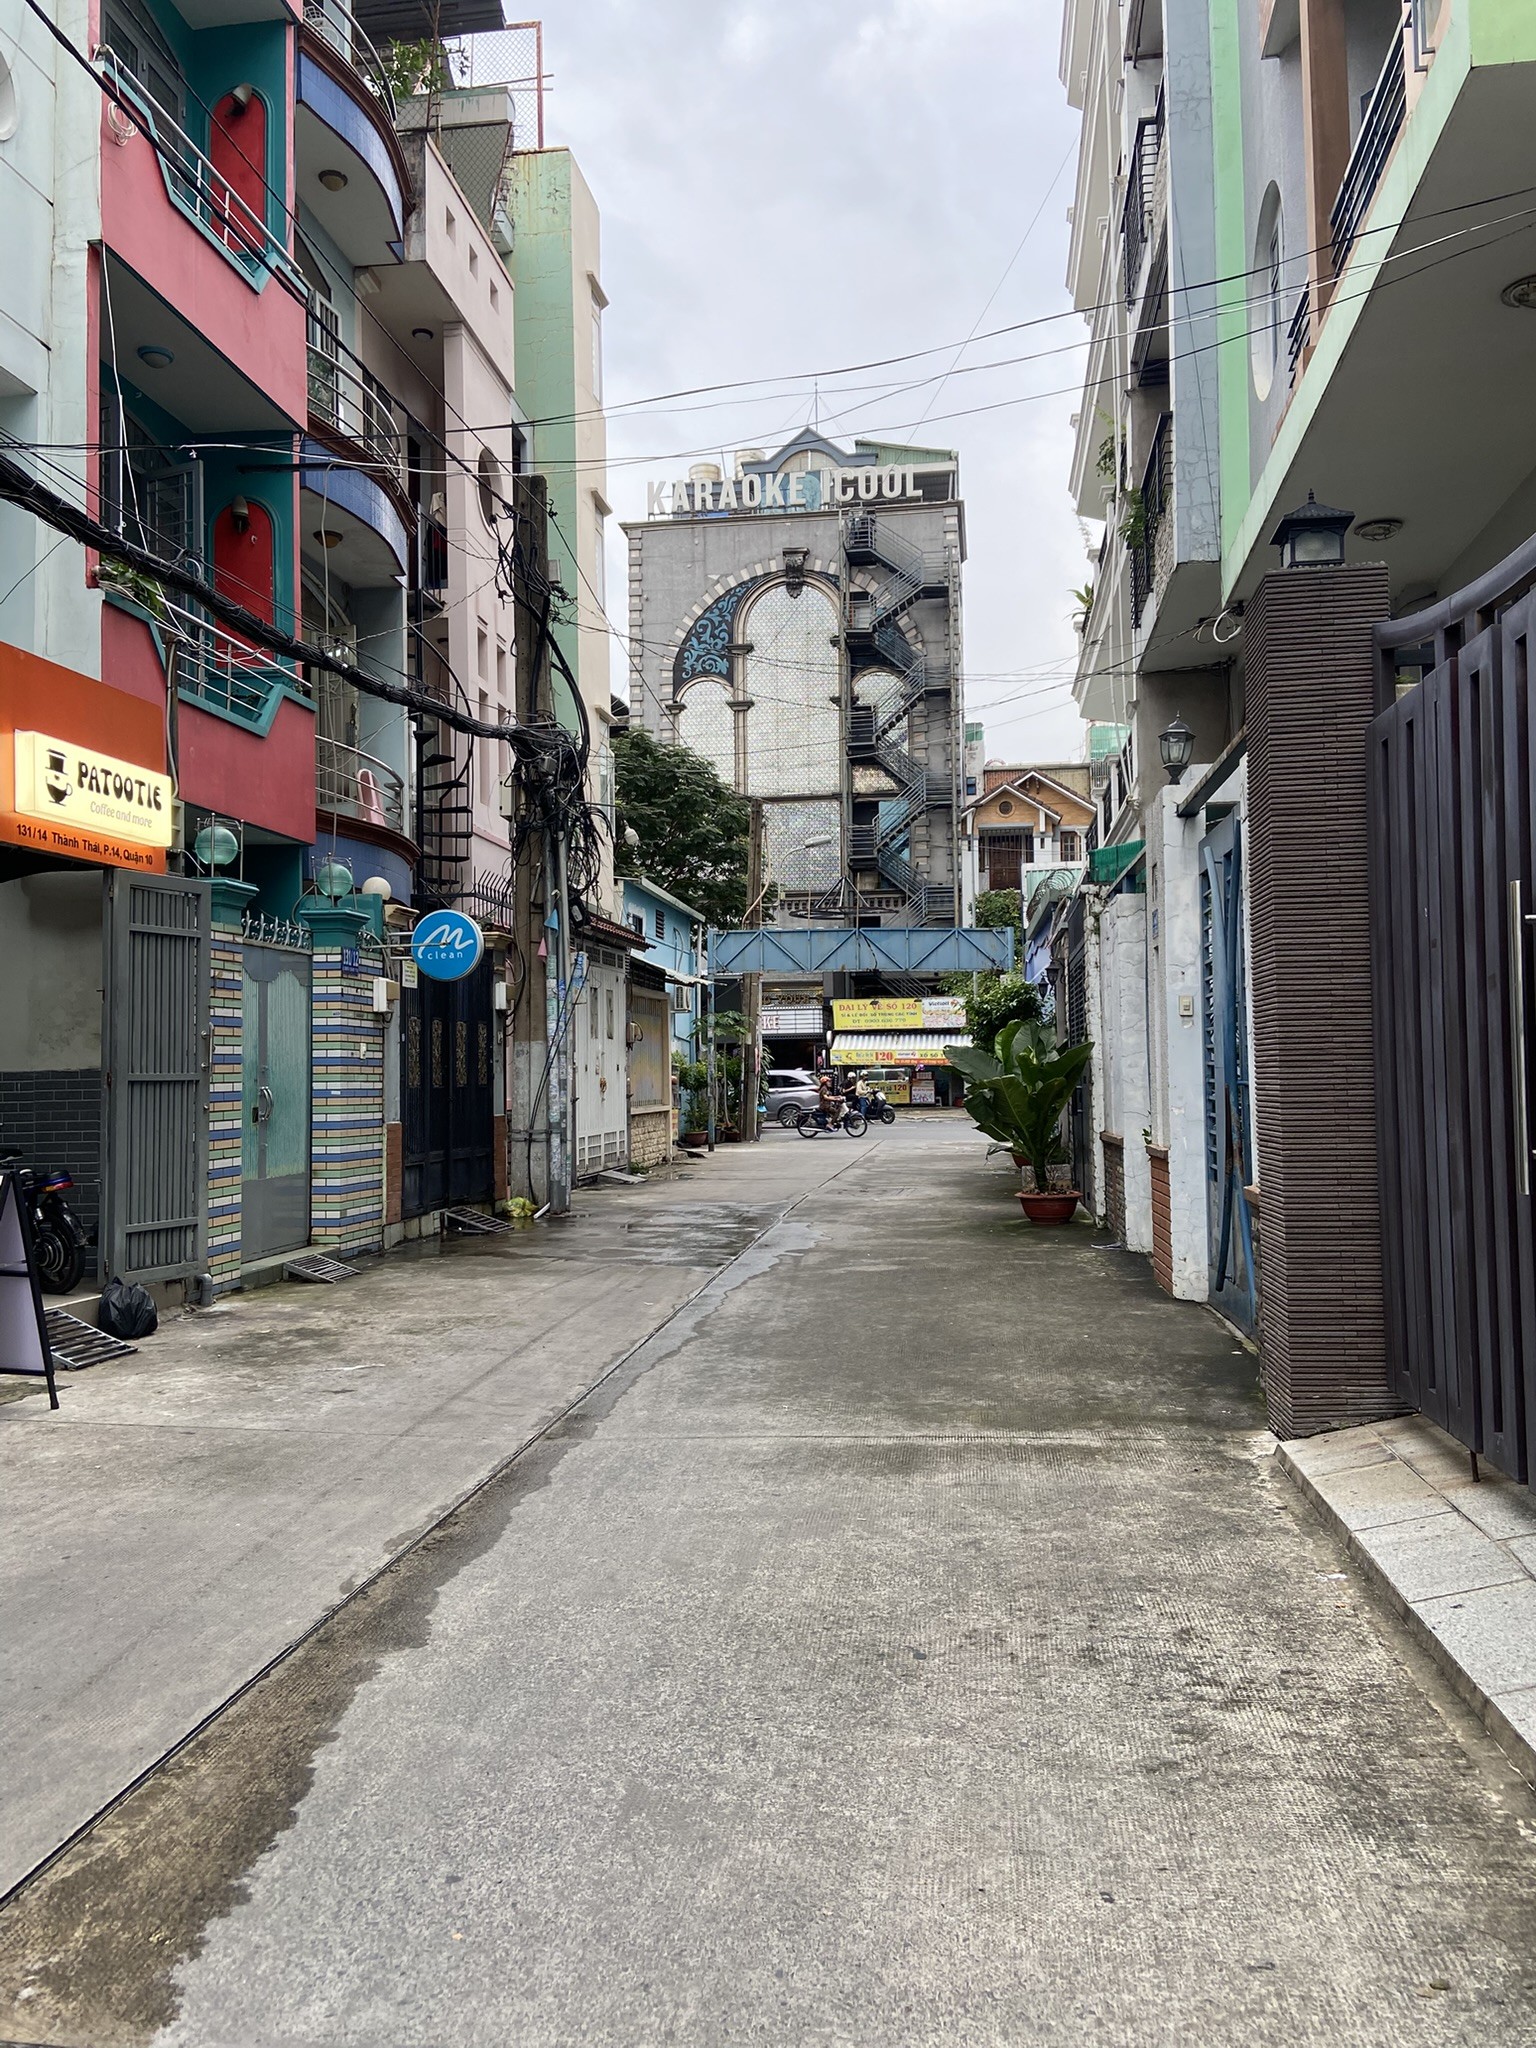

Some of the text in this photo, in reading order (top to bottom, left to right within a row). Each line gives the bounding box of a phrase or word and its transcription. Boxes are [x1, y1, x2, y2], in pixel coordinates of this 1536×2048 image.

[647, 464, 923, 513] KARAOKE ICOOL
[78, 760, 162, 811] PATOOTIE
[90, 801, 152, 828] Coffee and more
[17, 824, 47, 841] 131/14
[51, 832, 79, 848] Thành
[145, 854, 153, 865] 10
[427, 950, 463, 959] clean
[763, 1016, 780, 1029] KE
[875, 1052, 893, 1061] 120
